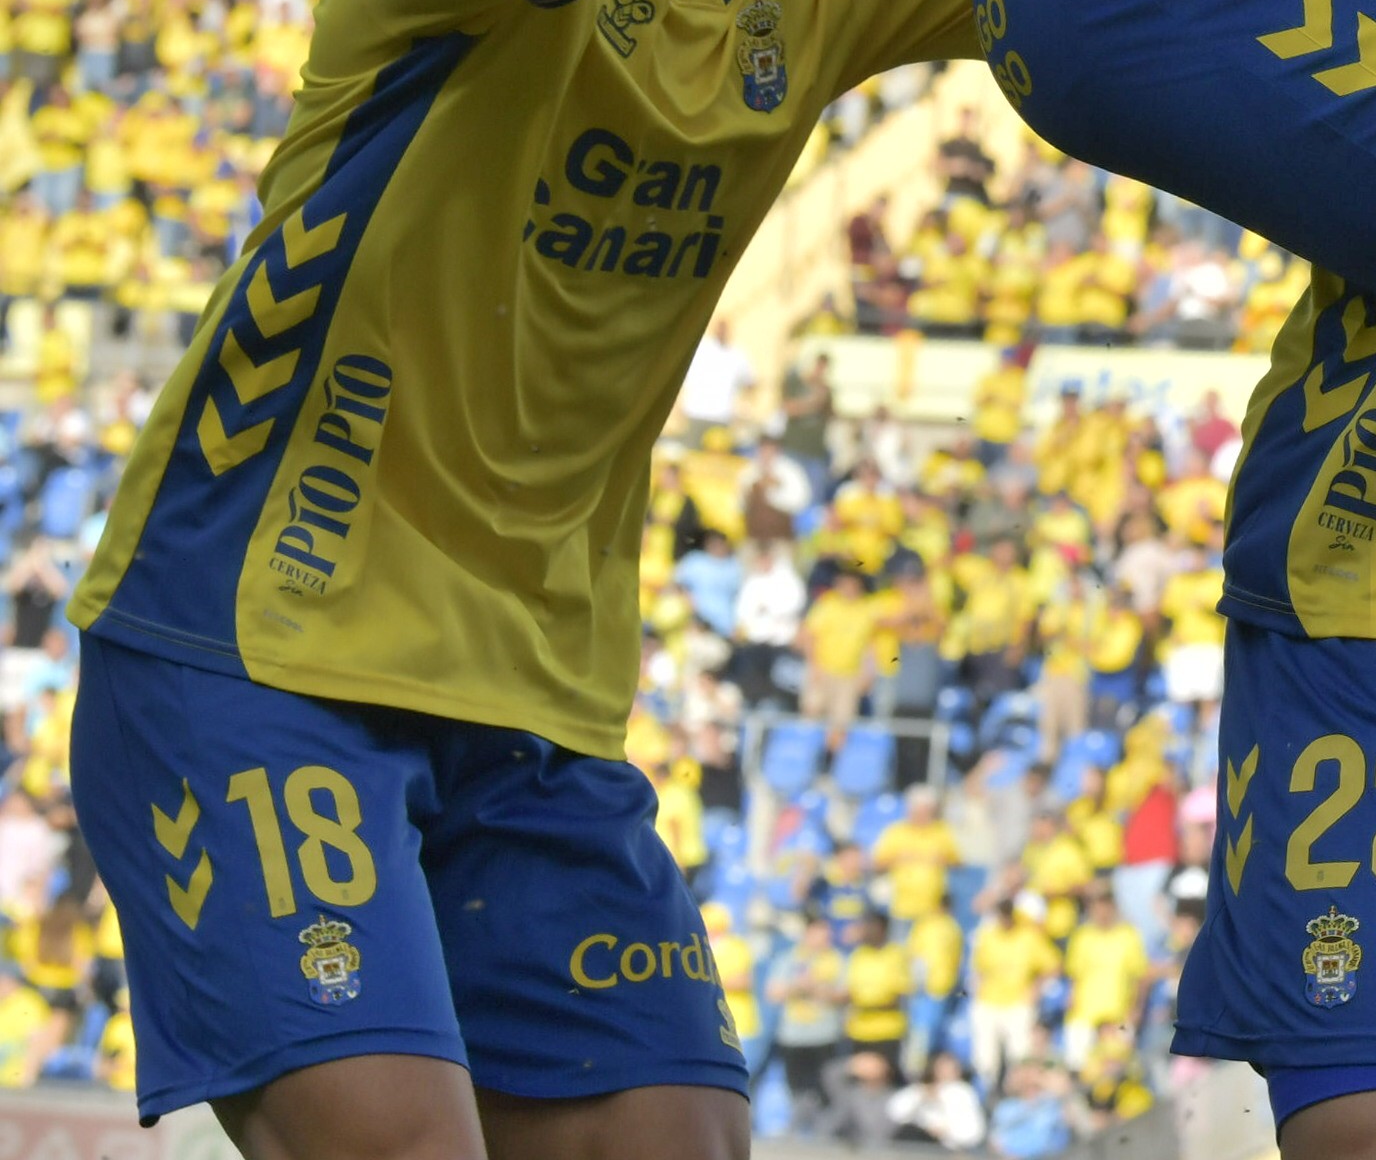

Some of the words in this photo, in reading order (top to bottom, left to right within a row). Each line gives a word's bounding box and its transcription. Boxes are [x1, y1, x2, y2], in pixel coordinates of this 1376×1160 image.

[1317, 511, 1375, 542] CERVEZA
[268, 557, 327, 596] CERVEZA
[226, 765, 377, 919] 18
